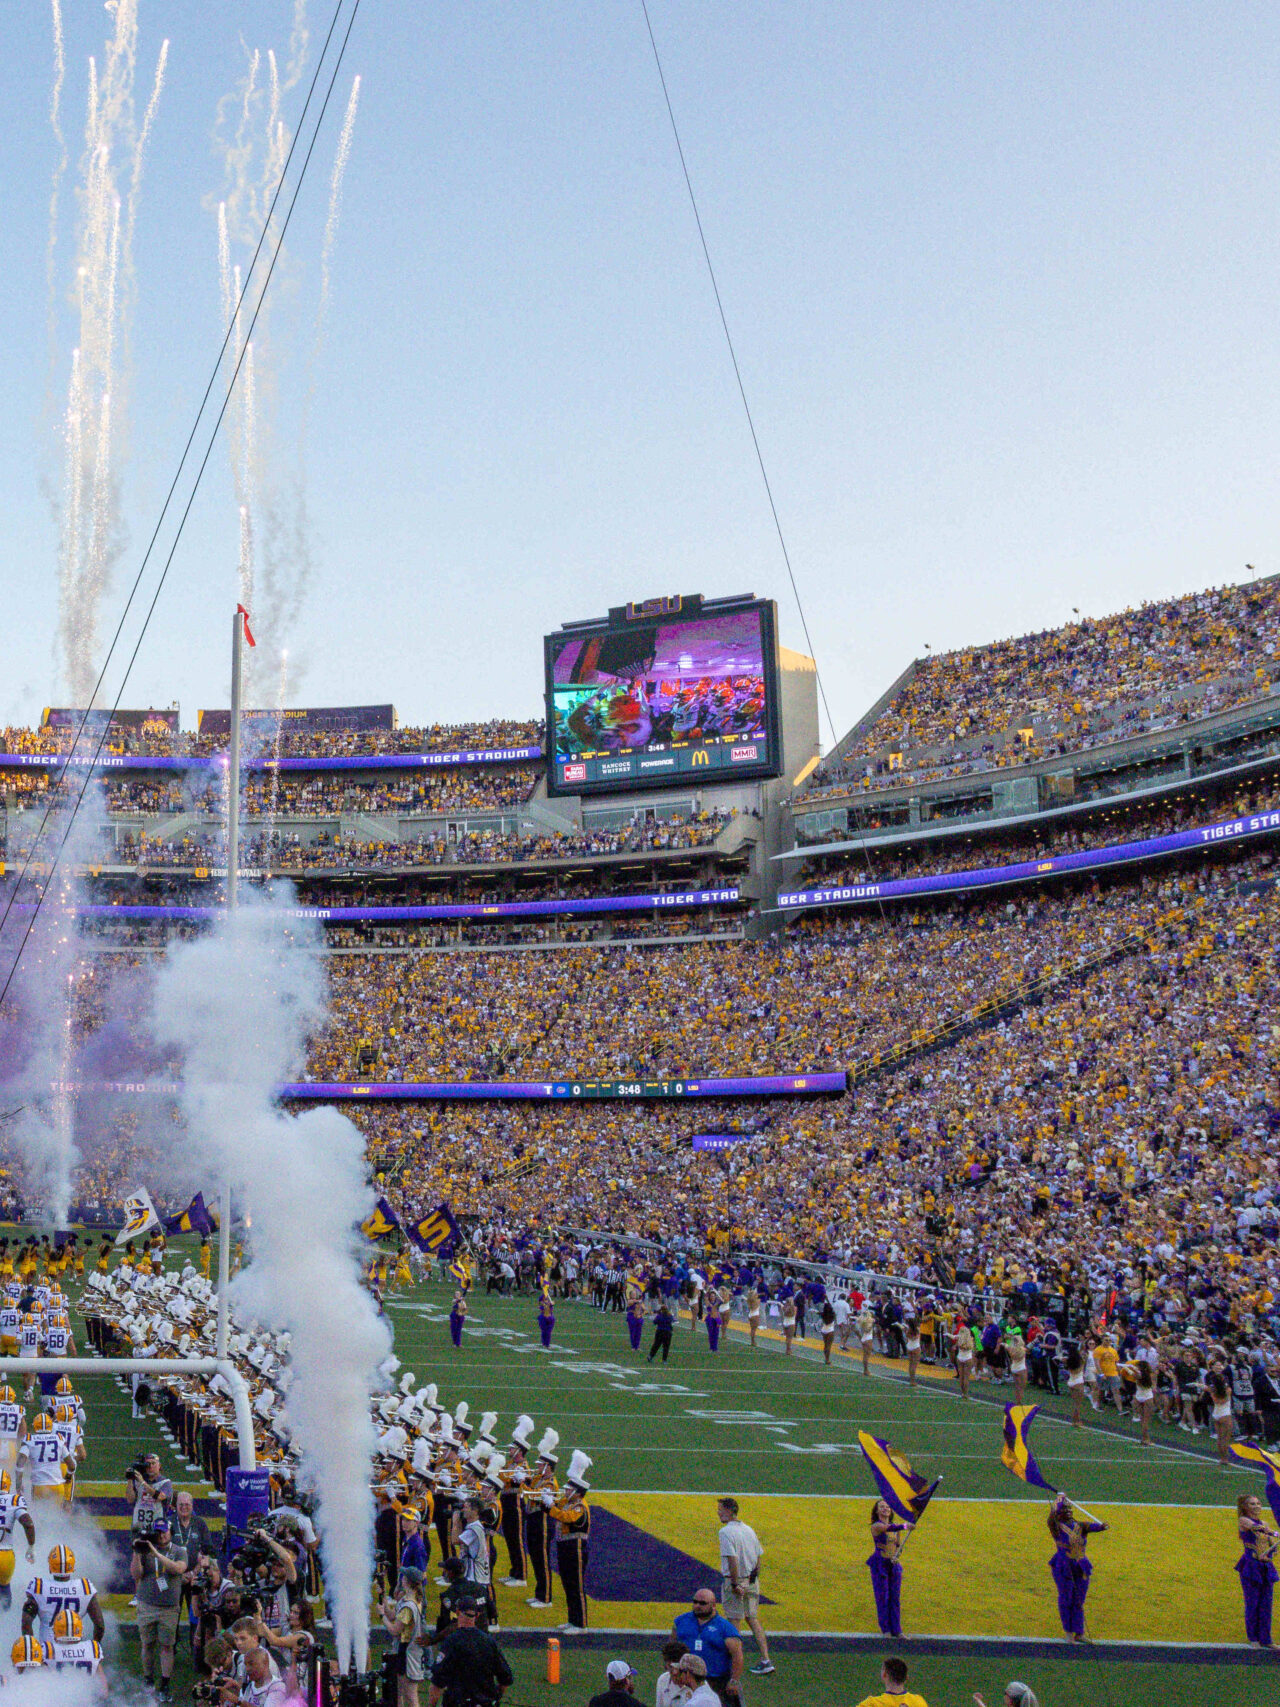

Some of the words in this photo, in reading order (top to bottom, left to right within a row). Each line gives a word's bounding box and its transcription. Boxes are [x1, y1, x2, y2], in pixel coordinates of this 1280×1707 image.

[626, 594, 682, 620] LSU
[422, 753, 460, 764] TIGER
[466, 749, 529, 762] STADIUM
[734, 749, 754, 759] MMR
[21, 756, 58, 766] TIGER
[64, 757, 123, 766] STADIUM
[602, 762, 631, 770] HANCOCK
[1201, 822, 1243, 841] TIGER
[1250, 813, 1280, 830] STA
[16, 862, 103, 878] VAEY
[1037, 862, 1052, 871] LSU
[652, 894, 694, 905] TIGER
[702, 889, 739, 901] STAD
[780, 894, 807, 906] GER
[814, 887, 880, 903] STADIUM
[573, 1084, 581, 1095] 0
[675, 1083, 683, 1093] 0
[794, 1080, 807, 1088] LSU
[544, 1085, 552, 1095] T
[618, 1085, 641, 1095] 3:48
[2, 1314, 17, 1326] 79
[25, 1332, 37, 1345] 18
[49, 1334, 64, 1348] 68
[34, 1440, 59, 1462] 73
[137, 1509, 154, 1523] 83
[49, 1586, 77, 1595] ECHOLS
[61, 1649, 85, 1659] KELLY
